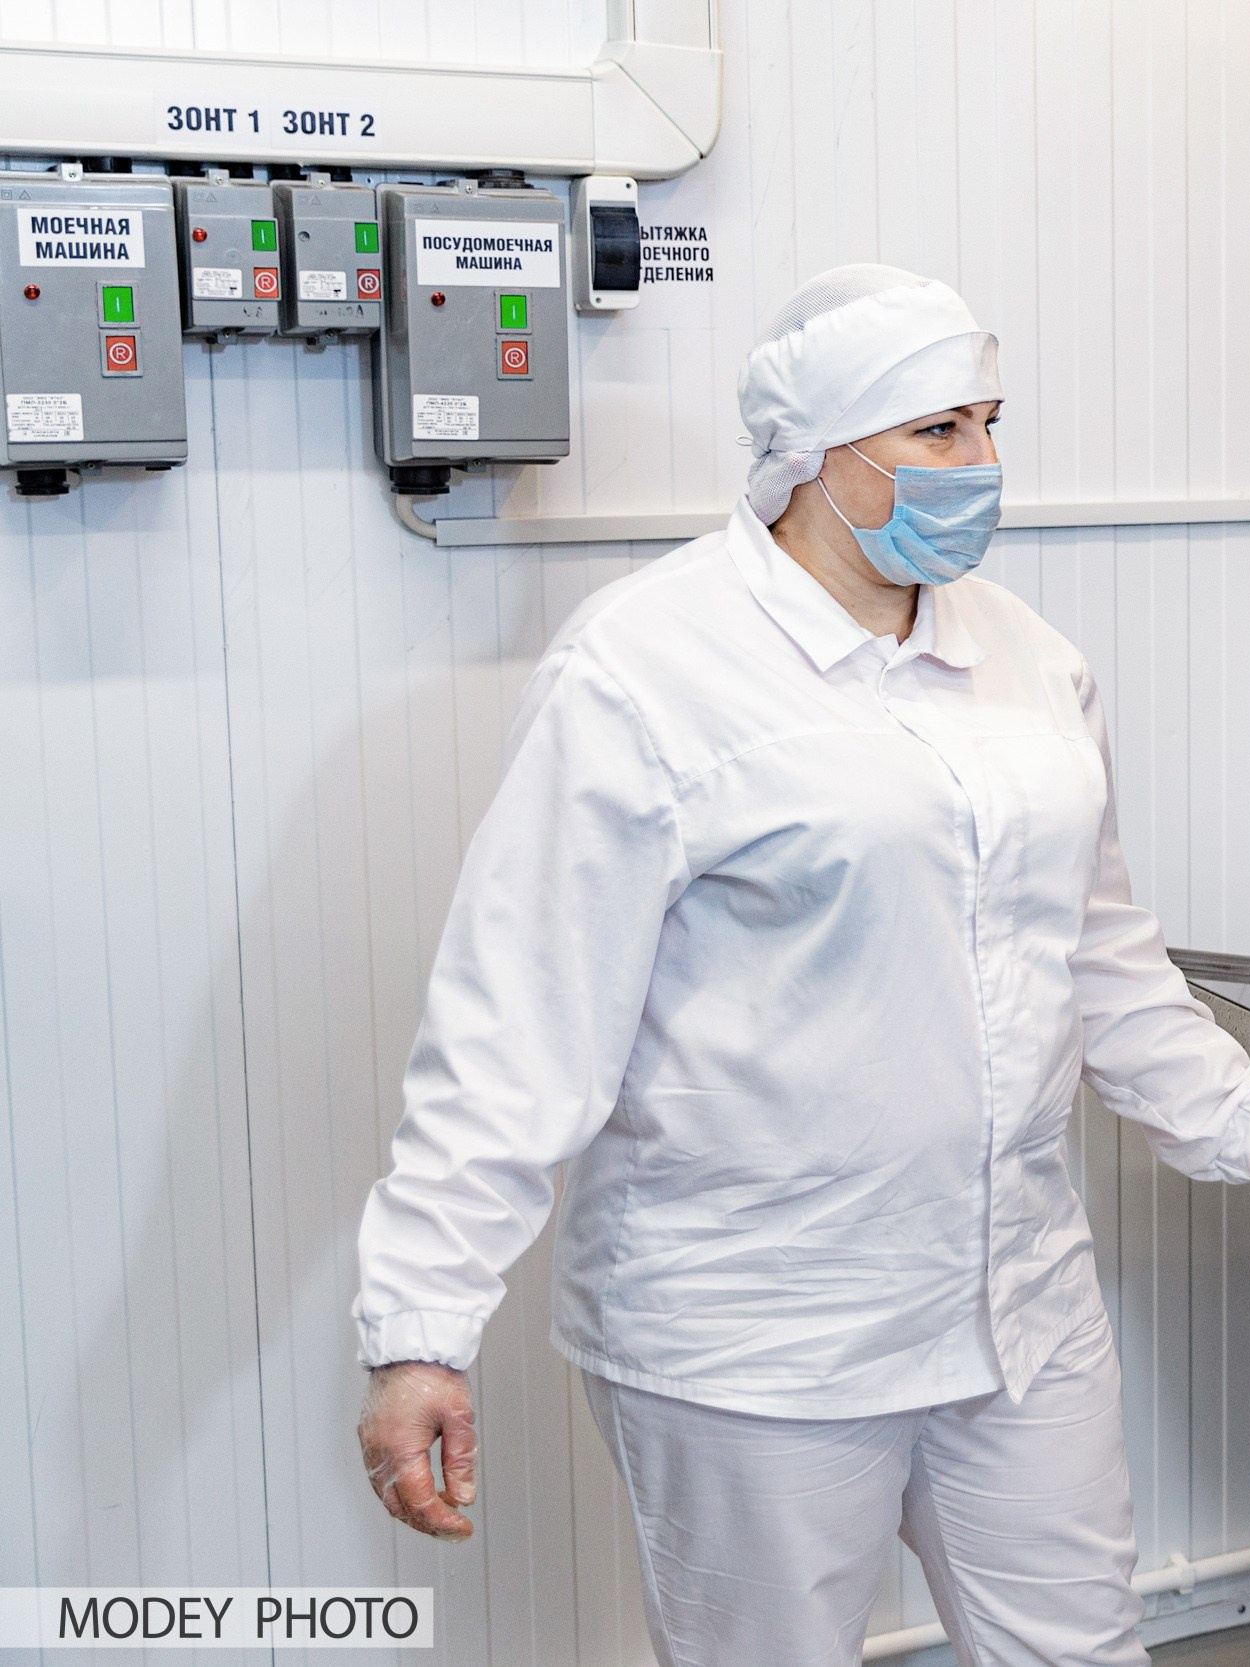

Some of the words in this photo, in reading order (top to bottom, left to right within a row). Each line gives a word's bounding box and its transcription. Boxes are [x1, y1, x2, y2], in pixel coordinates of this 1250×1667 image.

[167, 105, 237, 132] ЗОНТ
[247, 109, 260, 133] 1
[282, 110, 350, 136] ЗОНТ
[360, 113, 376, 137] 2
[30, 216, 130, 236] МОЕЧНАЯ
[640, 225, 708, 241] ЫТЯЖКА
[35, 241, 130, 260] МАШИНА
[422, 236, 553, 253] ПОСУДОМОЕЧНАЯ
[455, 255, 523, 271] МАШИНА
[642, 246, 710, 262] ОЕЧНОГО
[640, 266, 714, 284] ДЕЛЕНИЯ
